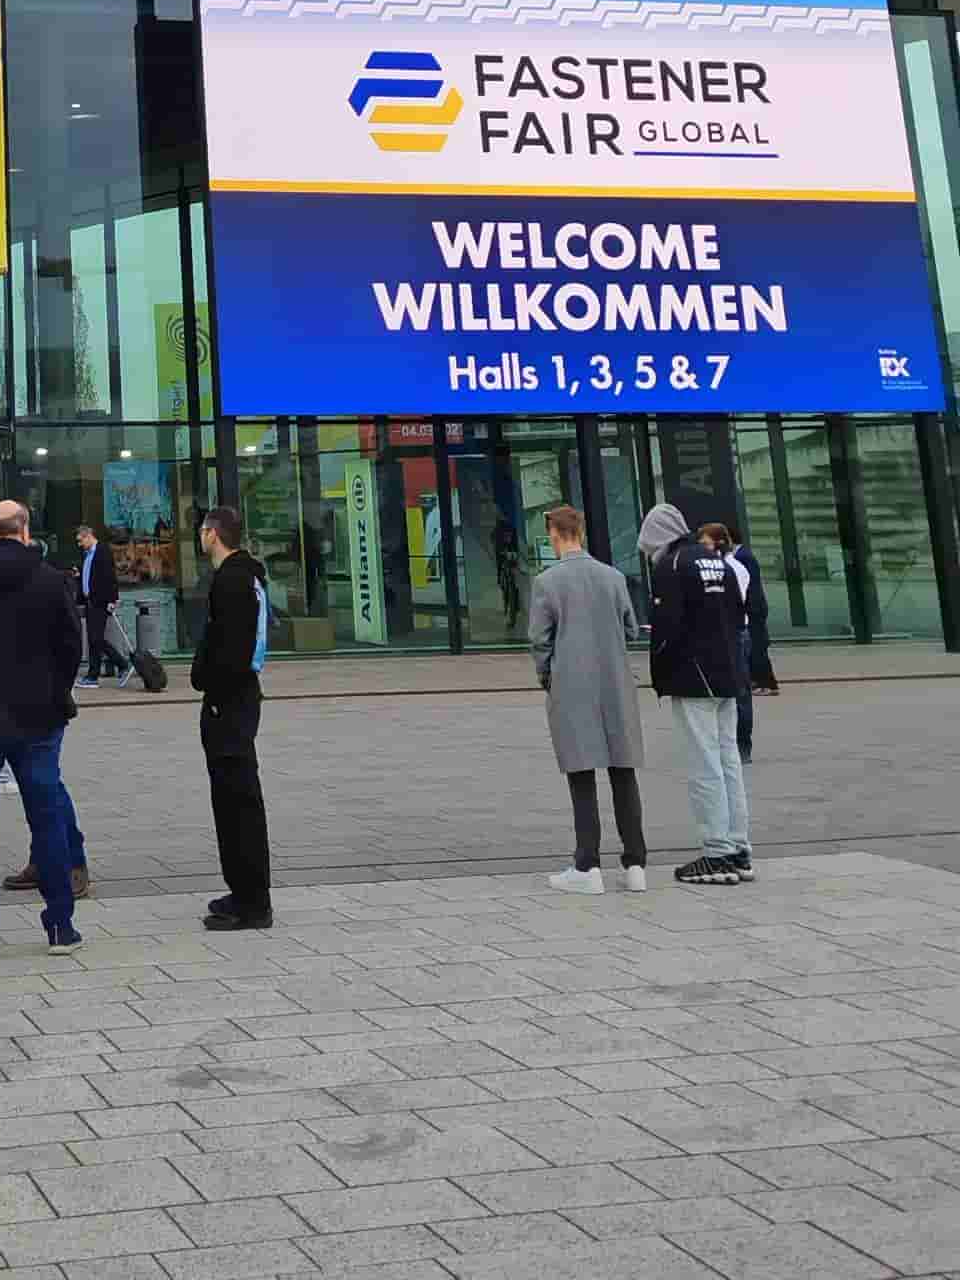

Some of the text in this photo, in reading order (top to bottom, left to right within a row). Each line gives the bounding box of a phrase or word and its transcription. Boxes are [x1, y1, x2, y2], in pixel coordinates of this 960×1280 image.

[474, 54, 772, 104] FASTENER
[479, 110, 770, 156] FAIR GLOBAL
[431, 221, 721, 272] WELCOME
[372, 282, 788, 333] WILLKOMMEN
[448, 352, 731, 397] Halls 1, 3, 5 & 7
[880, 357, 910, 377] RX
[357, 519, 372, 623] Allianz
